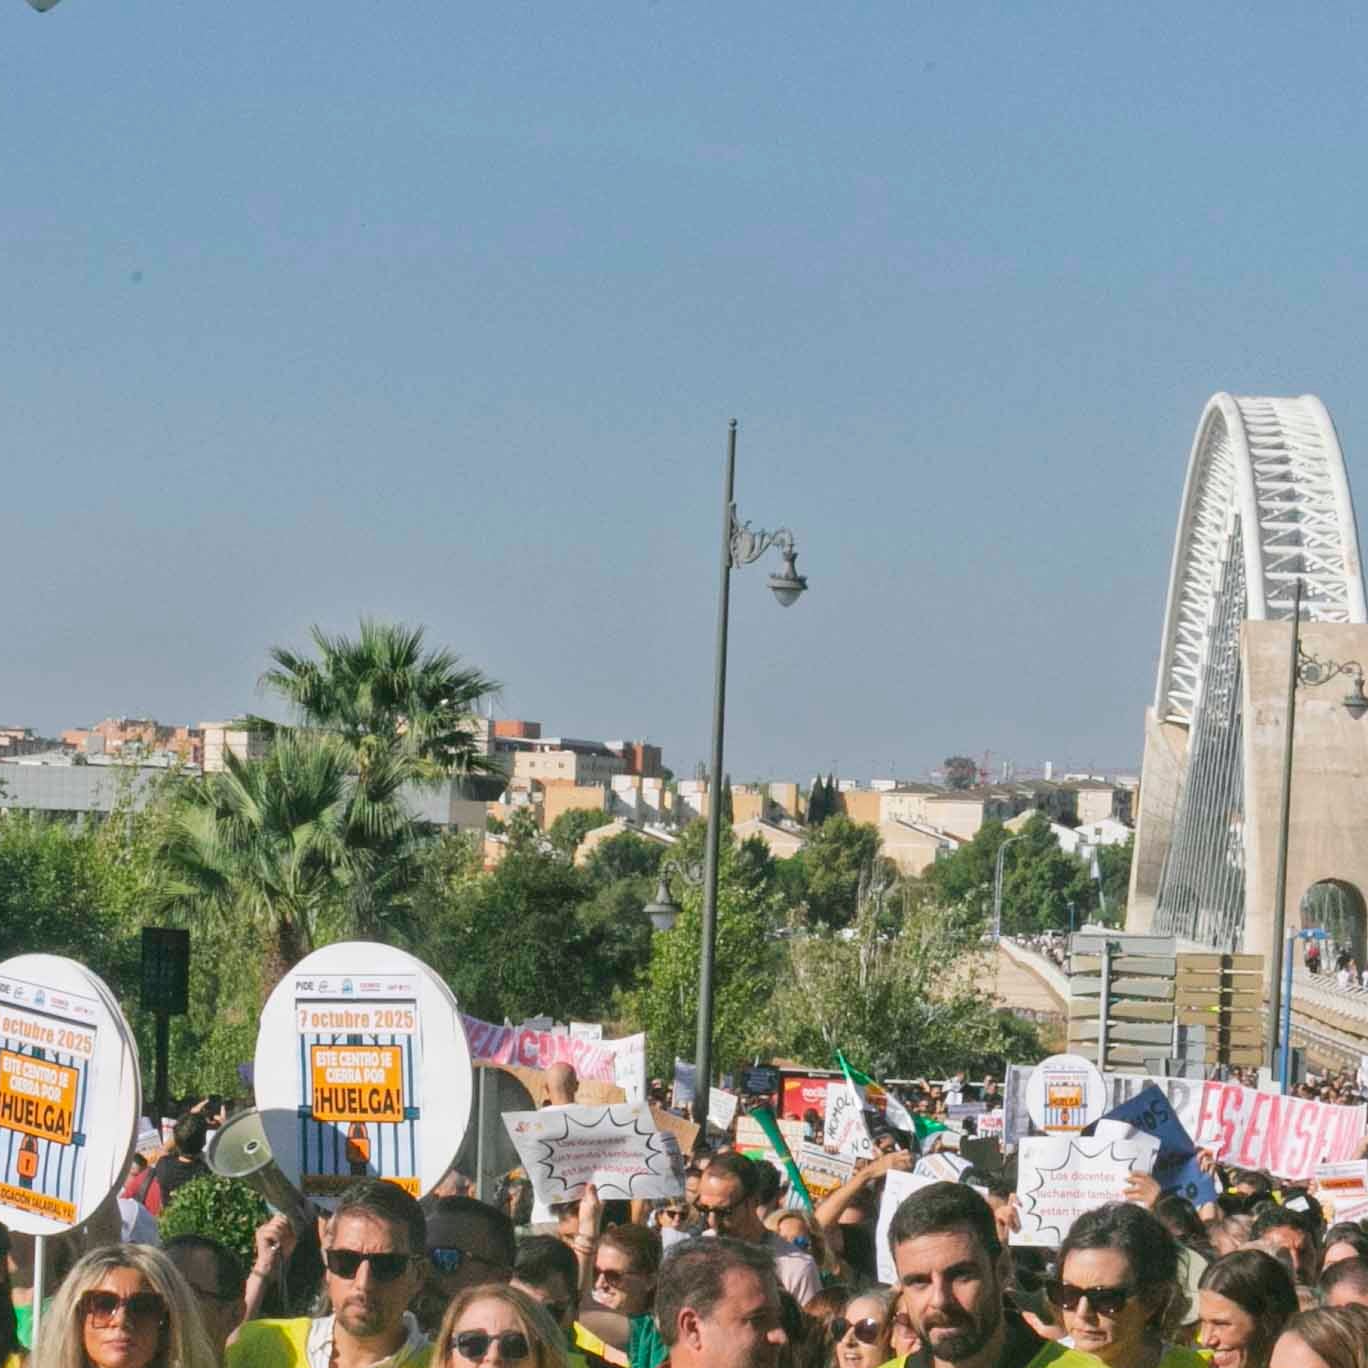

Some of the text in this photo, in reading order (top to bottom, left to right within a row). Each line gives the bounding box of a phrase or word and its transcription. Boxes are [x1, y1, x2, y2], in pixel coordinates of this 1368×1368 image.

[311, 1009, 370, 1029] octubre
[375, 1009, 414, 1029] 2025
[1, 1016, 55, 1046] octubre
[58, 1029, 94, 1054] 2025
[314, 1087, 401, 1115] ¡HUELGA!
